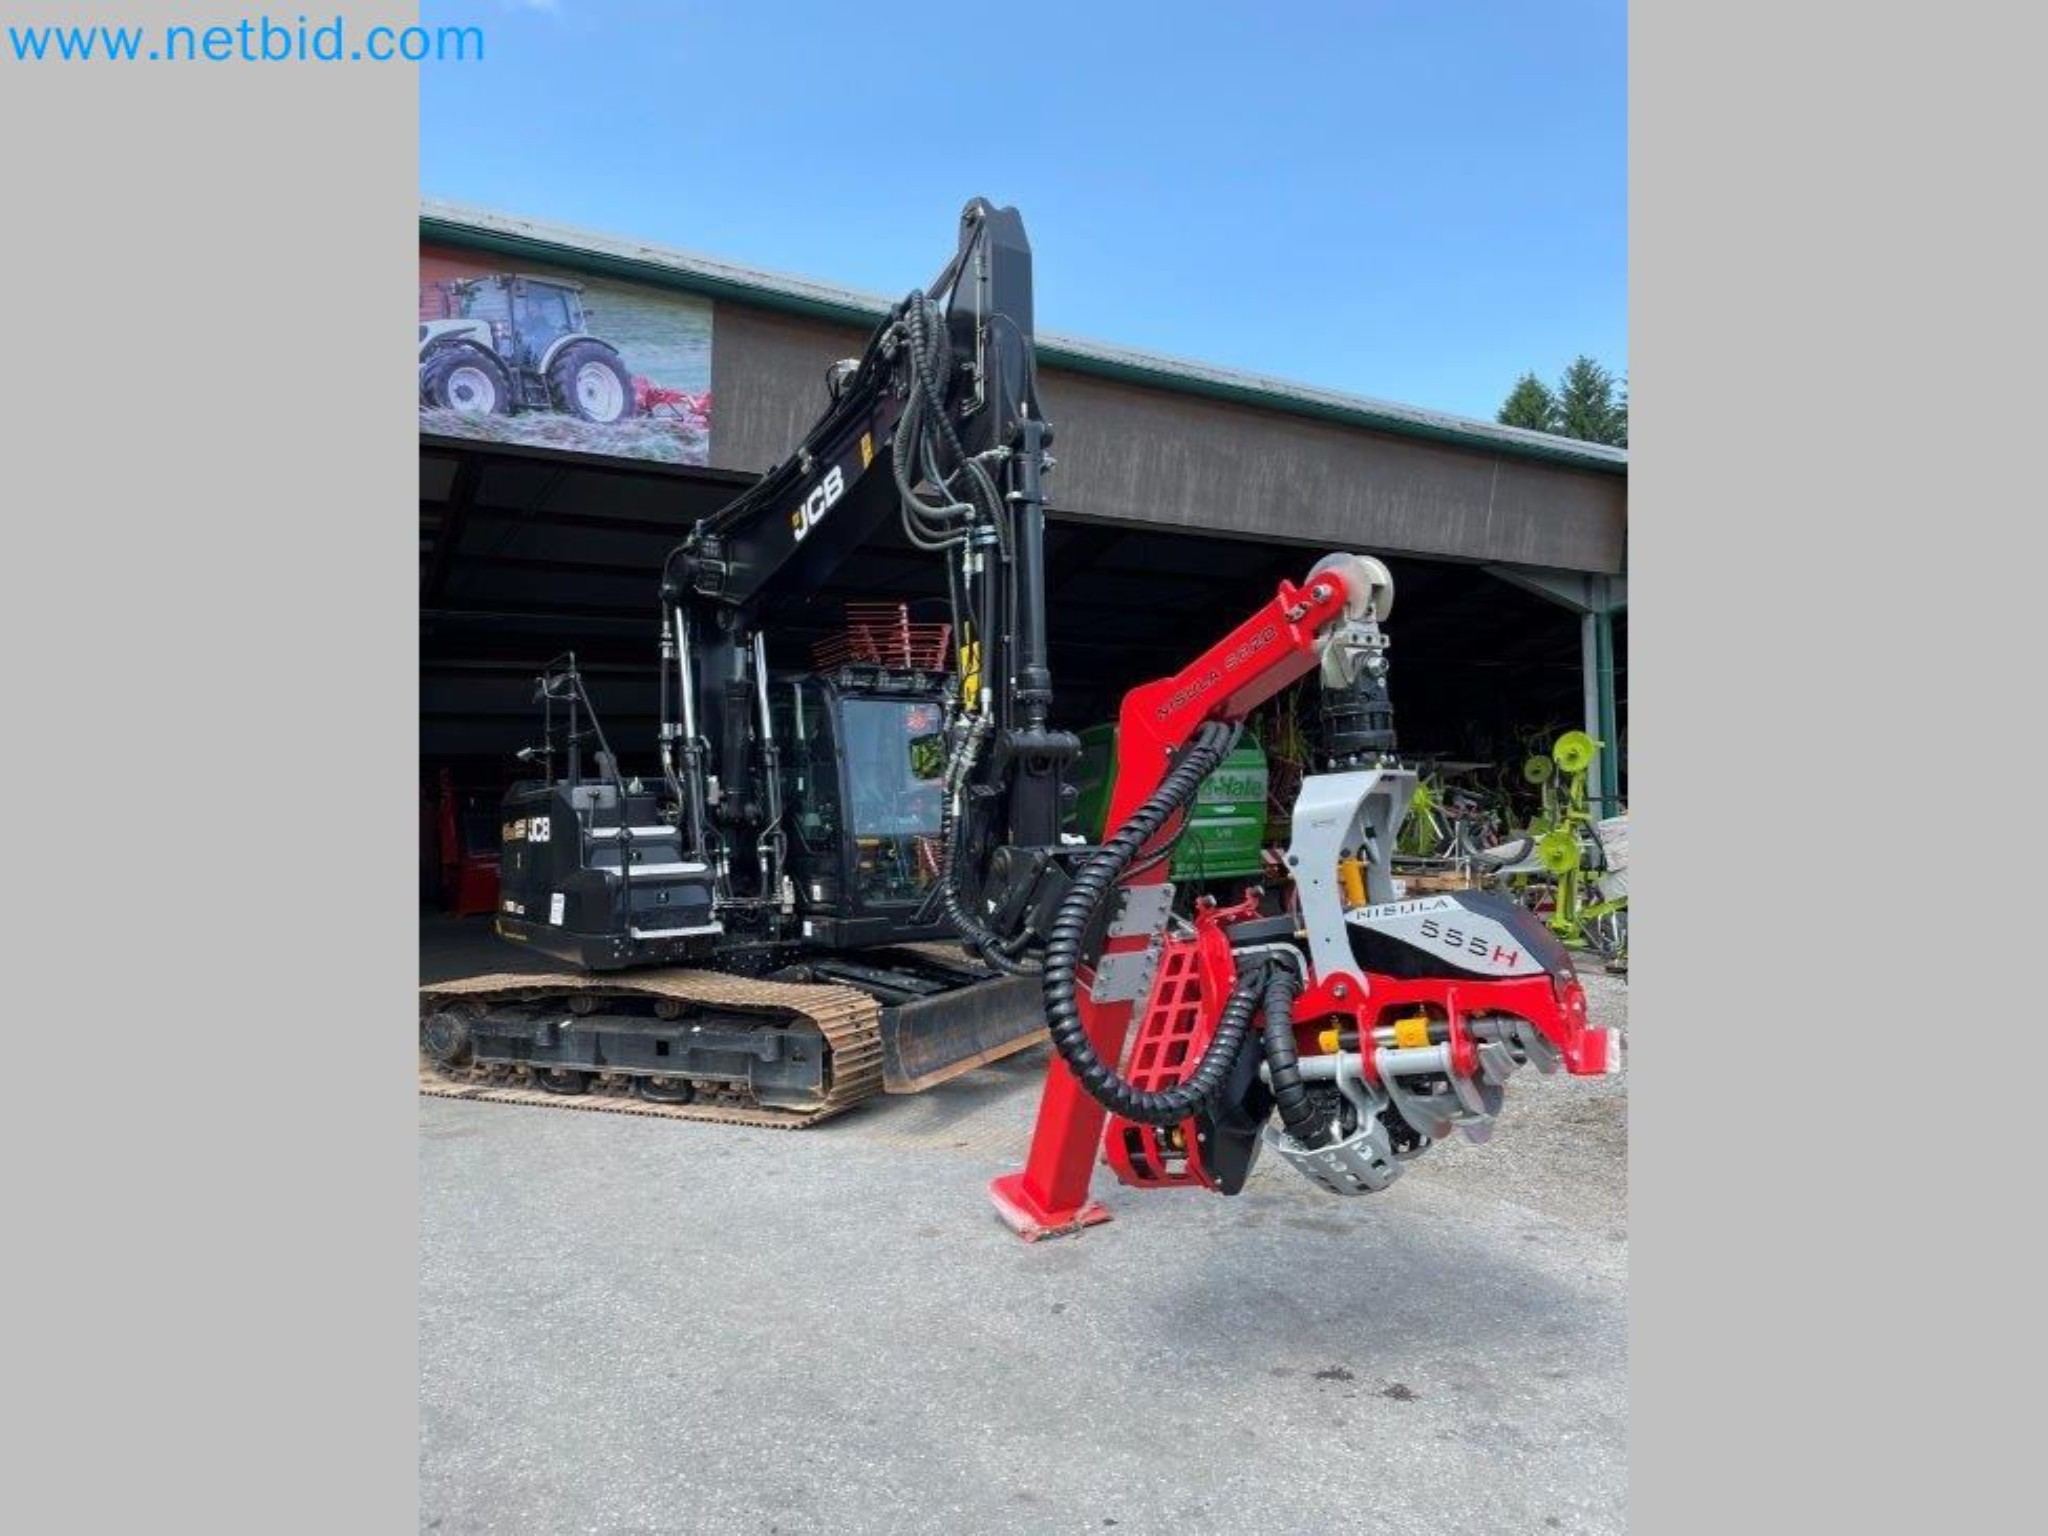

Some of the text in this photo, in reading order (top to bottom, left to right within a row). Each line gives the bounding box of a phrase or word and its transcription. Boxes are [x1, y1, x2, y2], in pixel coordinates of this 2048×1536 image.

[793, 465, 844, 541] JCB
[1156, 669, 1221, 720] NISULA
[528, 817, 550, 842] JCB
[1356, 898, 1449, 921] NISULA
[1420, 918, 1518, 968] 555H
